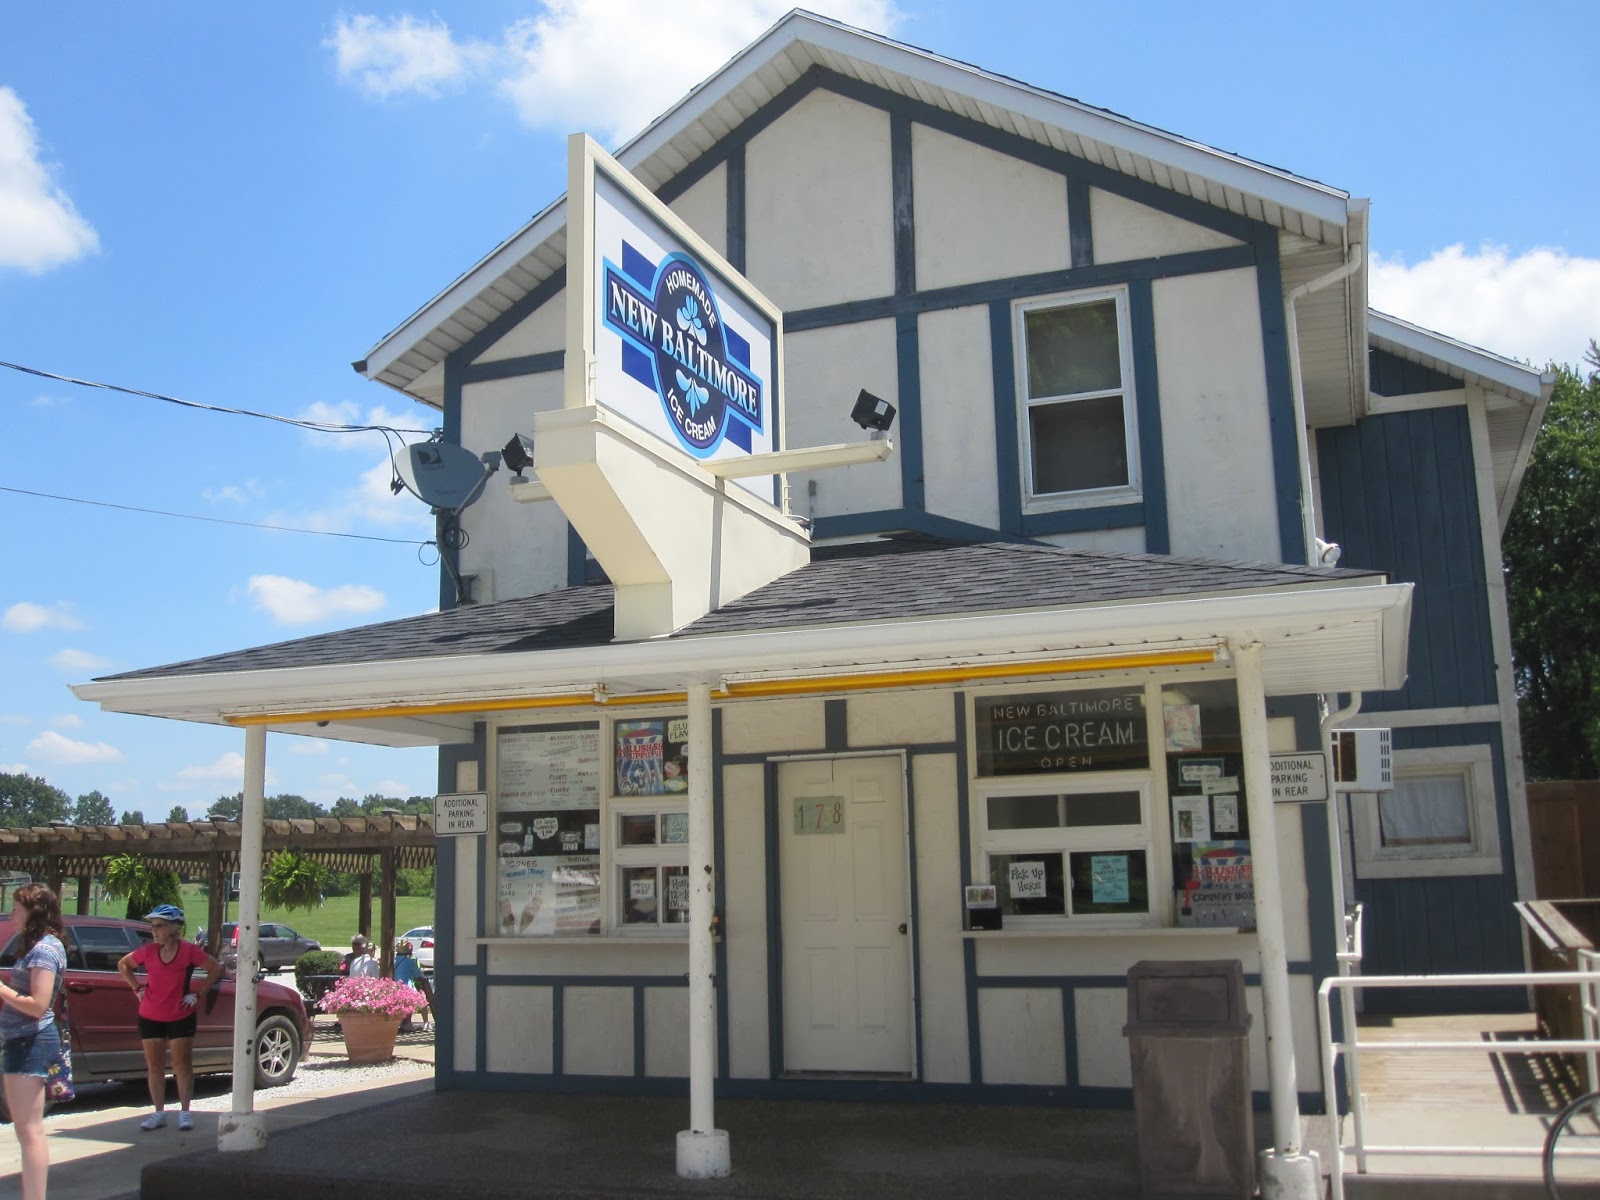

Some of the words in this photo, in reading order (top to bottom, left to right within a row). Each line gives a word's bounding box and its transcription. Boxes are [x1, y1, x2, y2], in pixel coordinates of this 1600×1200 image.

[665, 270, 717, 329] HOMEMADE
[610, 280, 658, 343] NEW
[661, 318, 758, 418] BALTIMORE
[667, 388, 684, 424] ICE
[684, 416, 716, 441] CREAM
[994, 705, 1030, 719] NEW
[1037, 698, 1134, 717] BALTIMORE
[673, 723, 688, 731] SLU
[999, 726, 1037, 751] ICE
[1045, 721, 1134, 749] CREAM
[1041, 756, 1092, 768] OPEN
[1270, 760, 1314, 771] DDITIONAL
[1271, 773, 1307, 784] PARKING
[1272, 787, 1281, 797] IN
[1285, 786, 1308, 796] REAR
[444, 799, 479, 808] ADDITIONAL
[448, 810, 474, 818] PARKING
[798, 801, 841, 831] 178
[448, 821, 455, 829] IN
[457, 820, 474, 828] REAR
[1017, 882, 1042, 892] HERE
[1192, 892, 1232, 902] COMMENT
